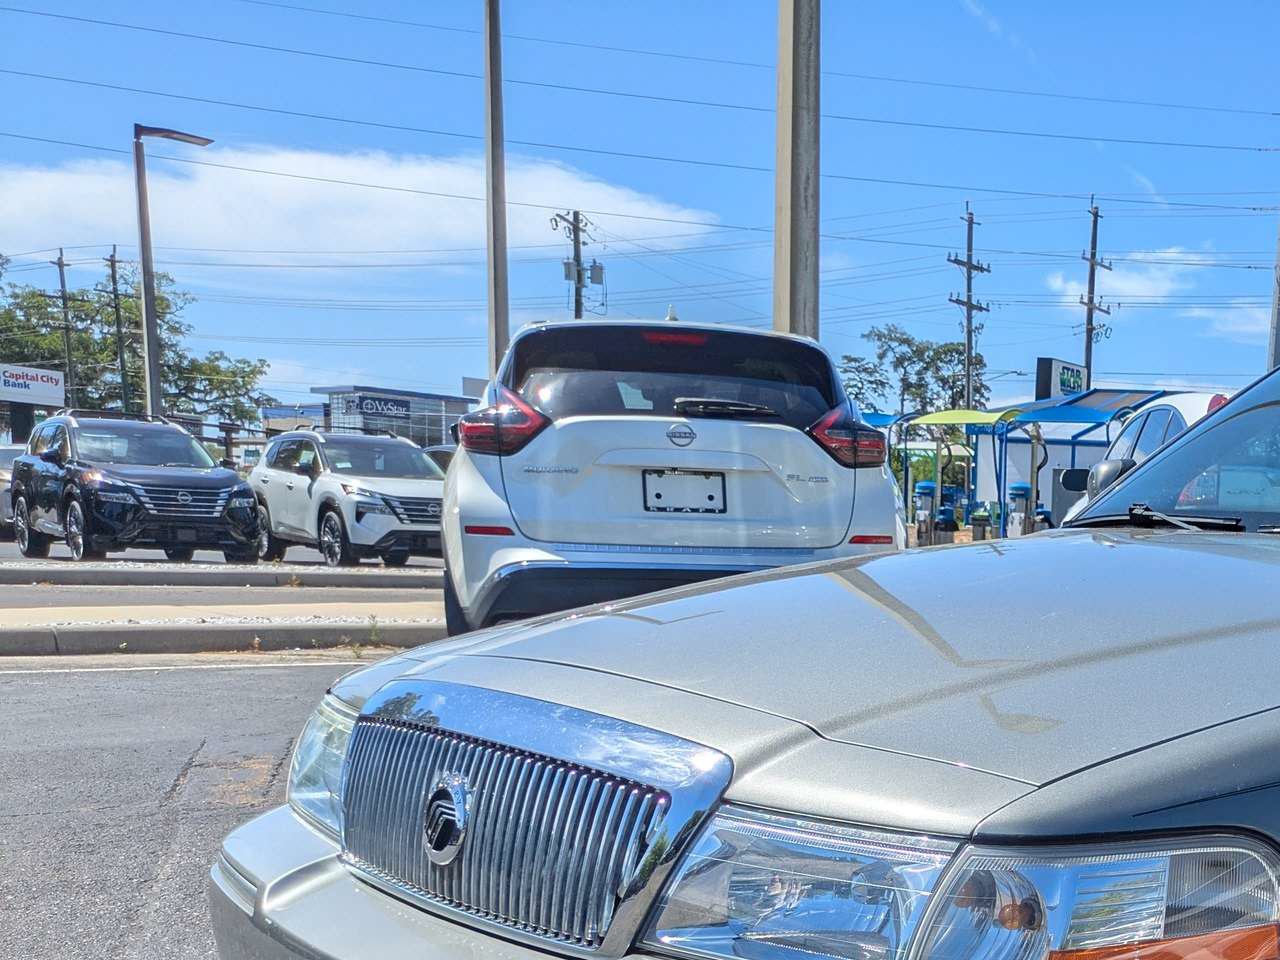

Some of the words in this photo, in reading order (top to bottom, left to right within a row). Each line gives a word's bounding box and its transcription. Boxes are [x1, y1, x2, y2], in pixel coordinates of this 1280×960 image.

[2, 370, 39, 382] Capital
[40, 374, 60, 386] City
[1060, 366, 1082, 380] STAR
[3, 379, 31, 390] Bank
[1060, 377, 1082, 391] WASH
[375, 401, 407, 413] VyStar
